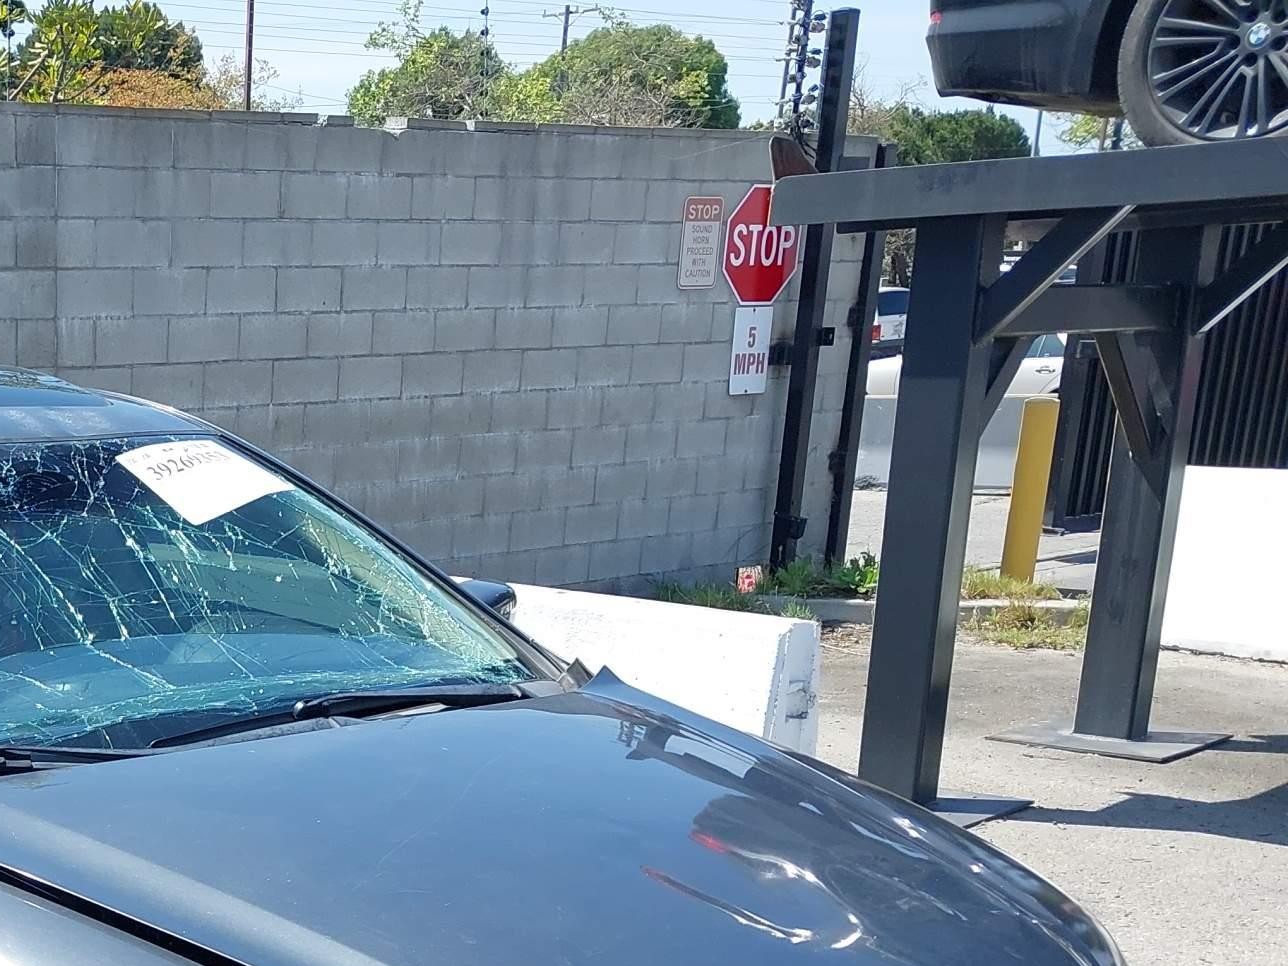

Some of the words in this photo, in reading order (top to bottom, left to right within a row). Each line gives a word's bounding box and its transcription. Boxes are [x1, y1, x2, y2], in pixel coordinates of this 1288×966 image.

[688, 204, 721, 220] STOP
[691, 224, 713, 234] SOUND
[692, 235, 710, 245] HORN
[729, 223, 796, 267] STOP
[686, 246, 714, 256] PROCEED
[691, 257, 706, 267] WITH
[684, 268, 711, 278] CAUTION
[747, 326, 757, 348] 5
[733, 352, 766, 375] MPH
